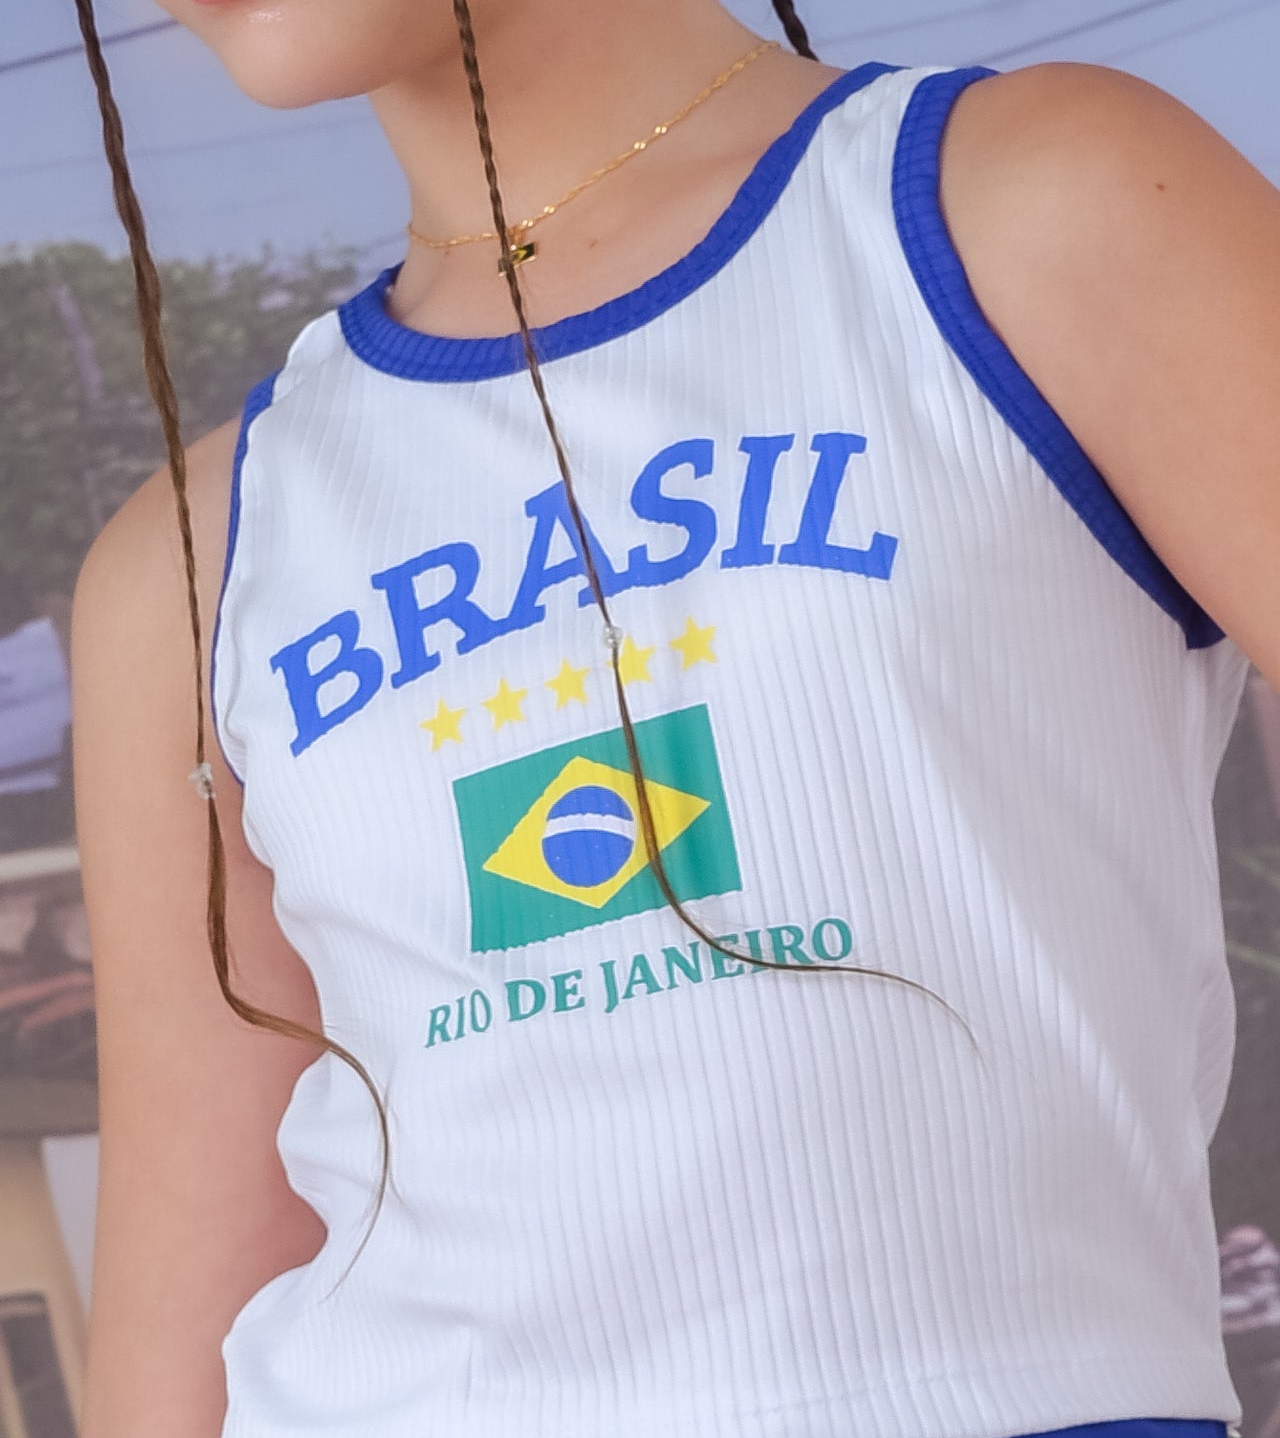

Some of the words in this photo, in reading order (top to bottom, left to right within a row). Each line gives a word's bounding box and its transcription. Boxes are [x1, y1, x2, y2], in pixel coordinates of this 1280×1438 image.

[270, 432, 899, 757] BRASIL
[424, 988, 492, 1048] RIO
[504, 970, 586, 1023] DE
[601, 917, 853, 1014] JANEIRO
